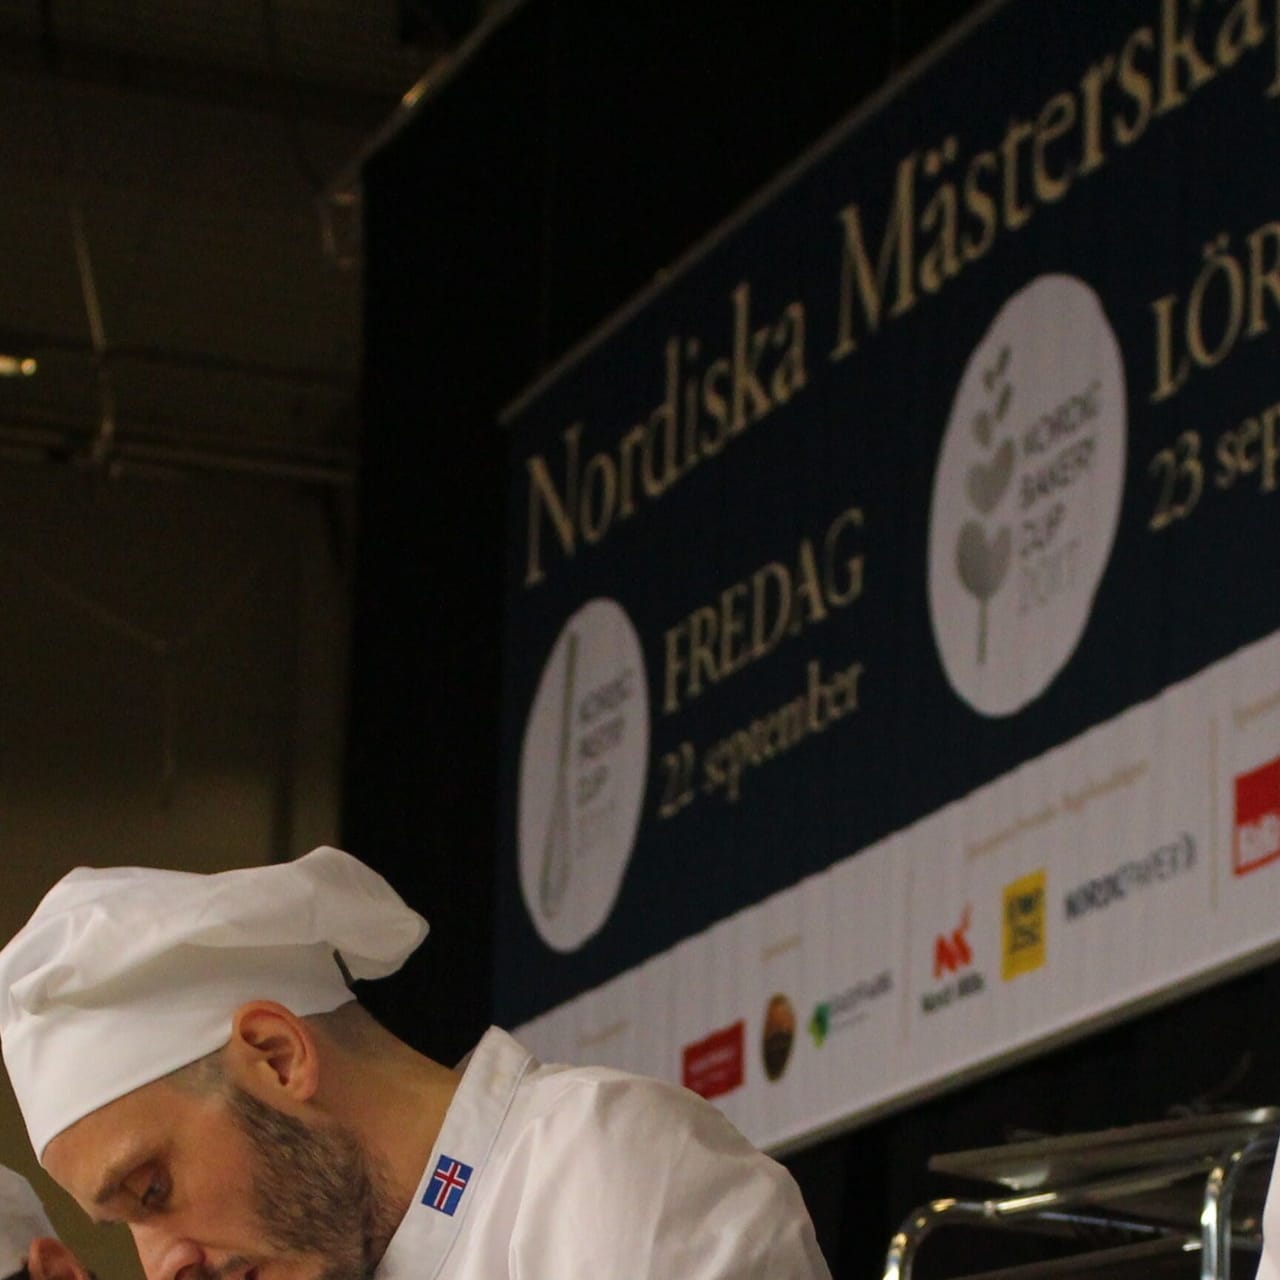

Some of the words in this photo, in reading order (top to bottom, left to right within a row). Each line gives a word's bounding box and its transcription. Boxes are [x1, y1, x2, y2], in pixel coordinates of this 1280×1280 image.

[526, 281, 809, 588] Nordiska
[1148, 429, 1205, 533] 23
[663, 506, 864, 715] FREDAG
[658, 741, 697, 820] 22
[703, 659, 865, 803] september
